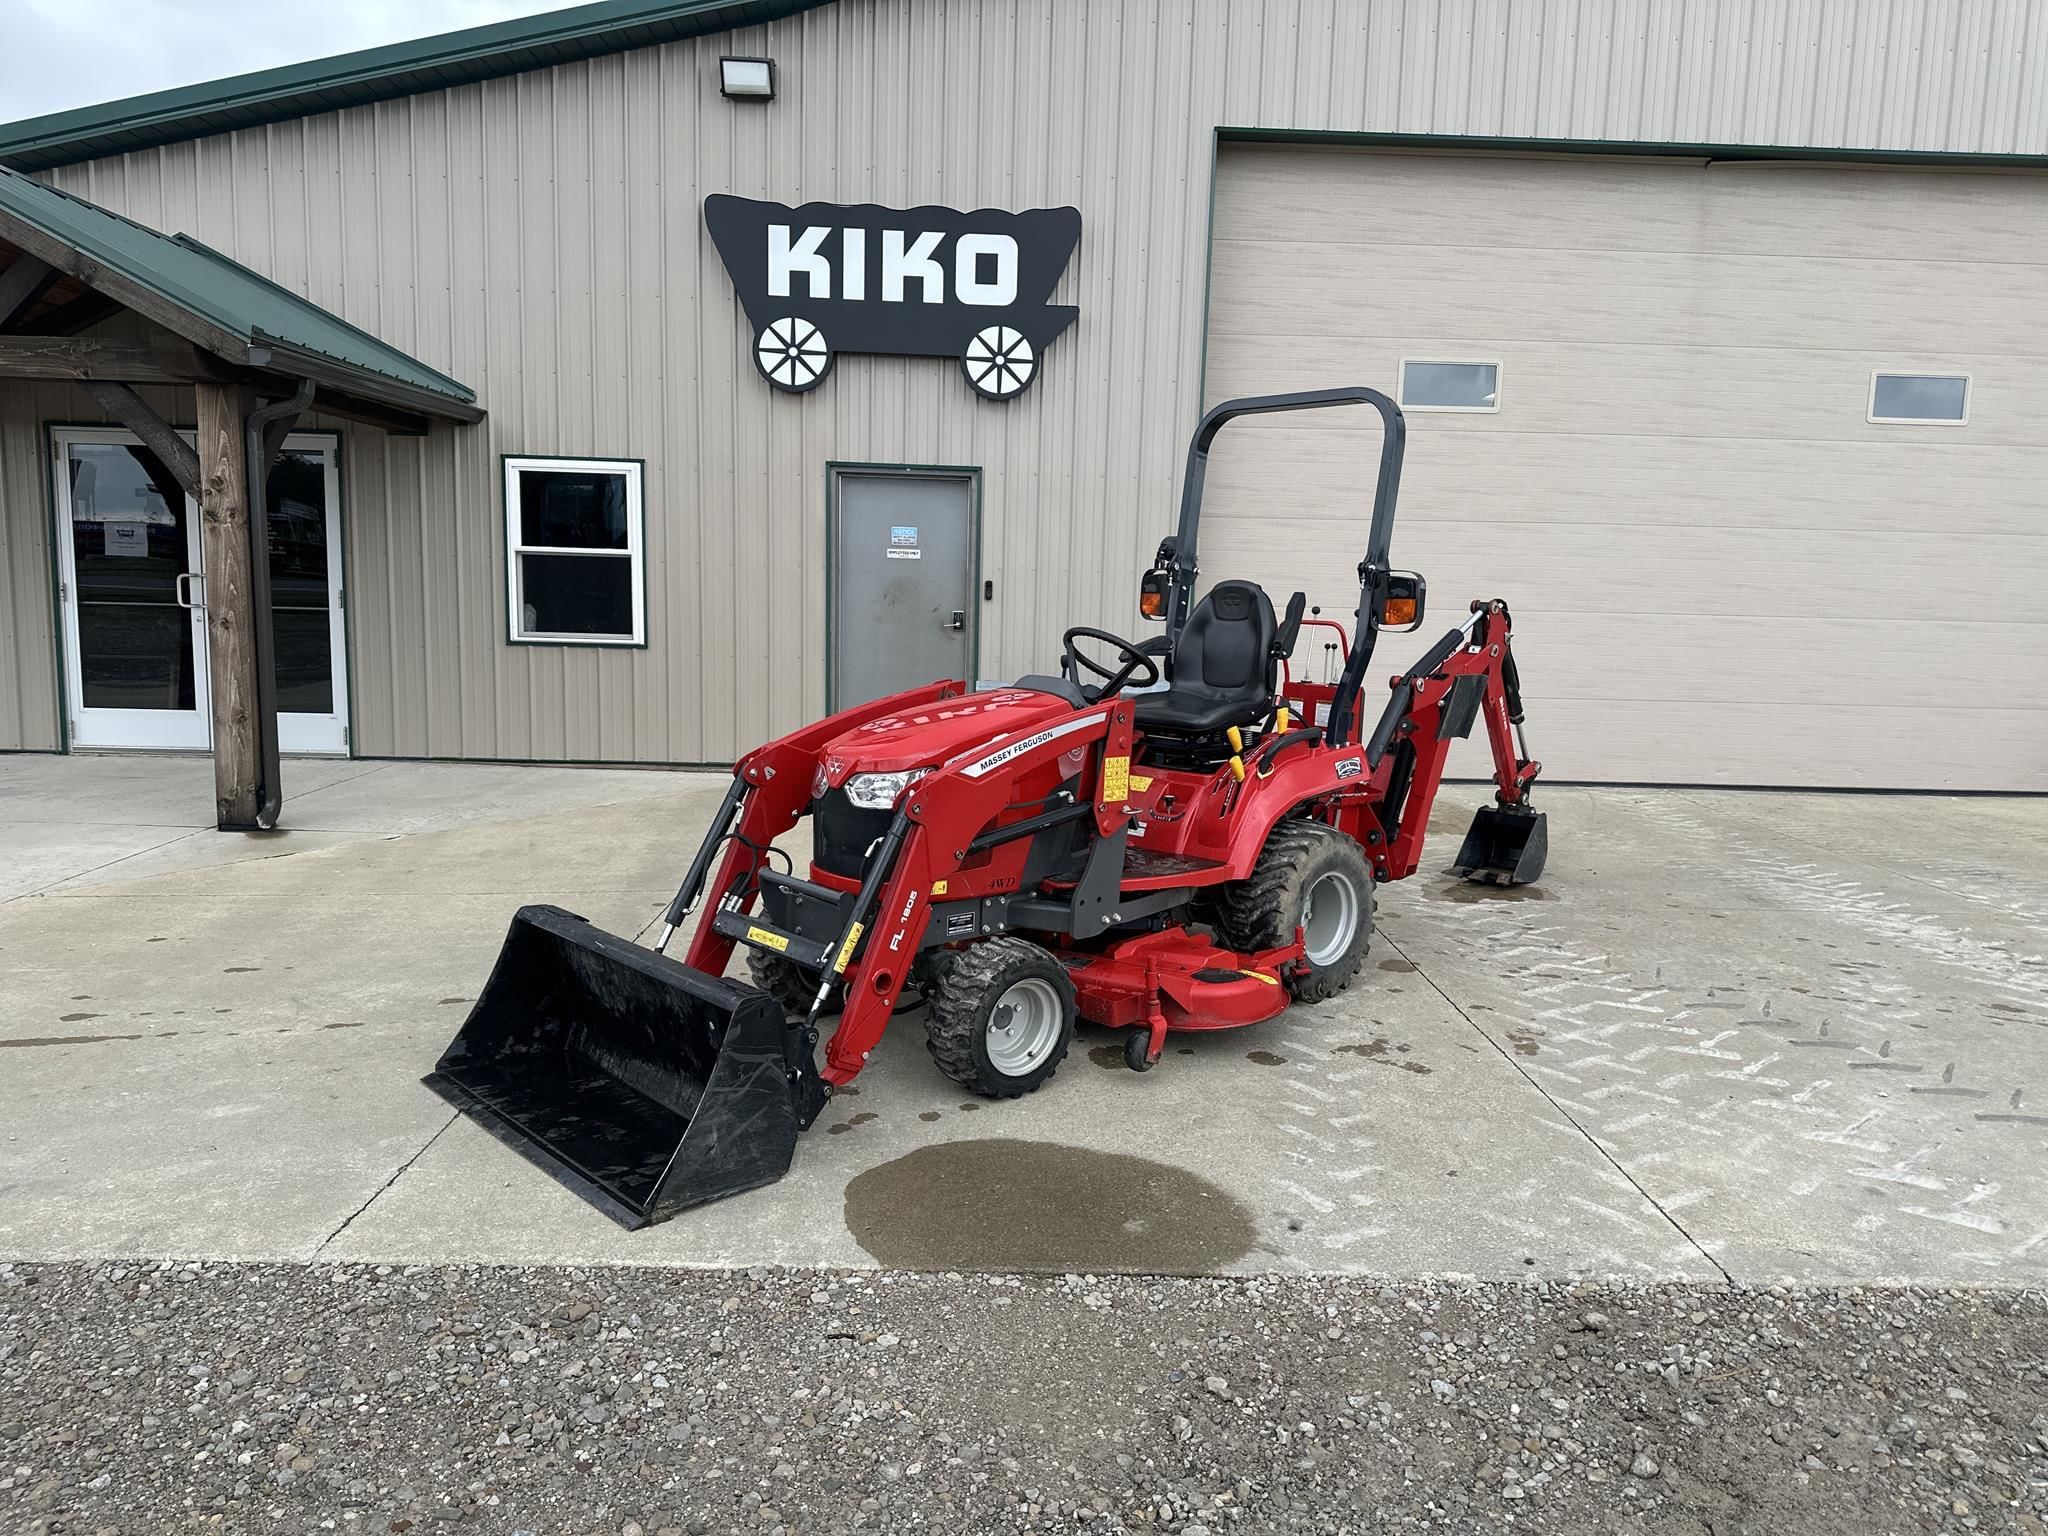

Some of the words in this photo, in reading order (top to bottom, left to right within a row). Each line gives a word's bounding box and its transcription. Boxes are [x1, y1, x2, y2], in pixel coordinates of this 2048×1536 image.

[767, 224, 1019, 307] KIKO
[980, 749, 1012, 771] MASSEY
[1013, 731, 1054, 754] FERGUSON
[987, 877, 1016, 890] 4WD
[889, 929, 905, 952] FL
[900, 890, 918, 924] 1805
